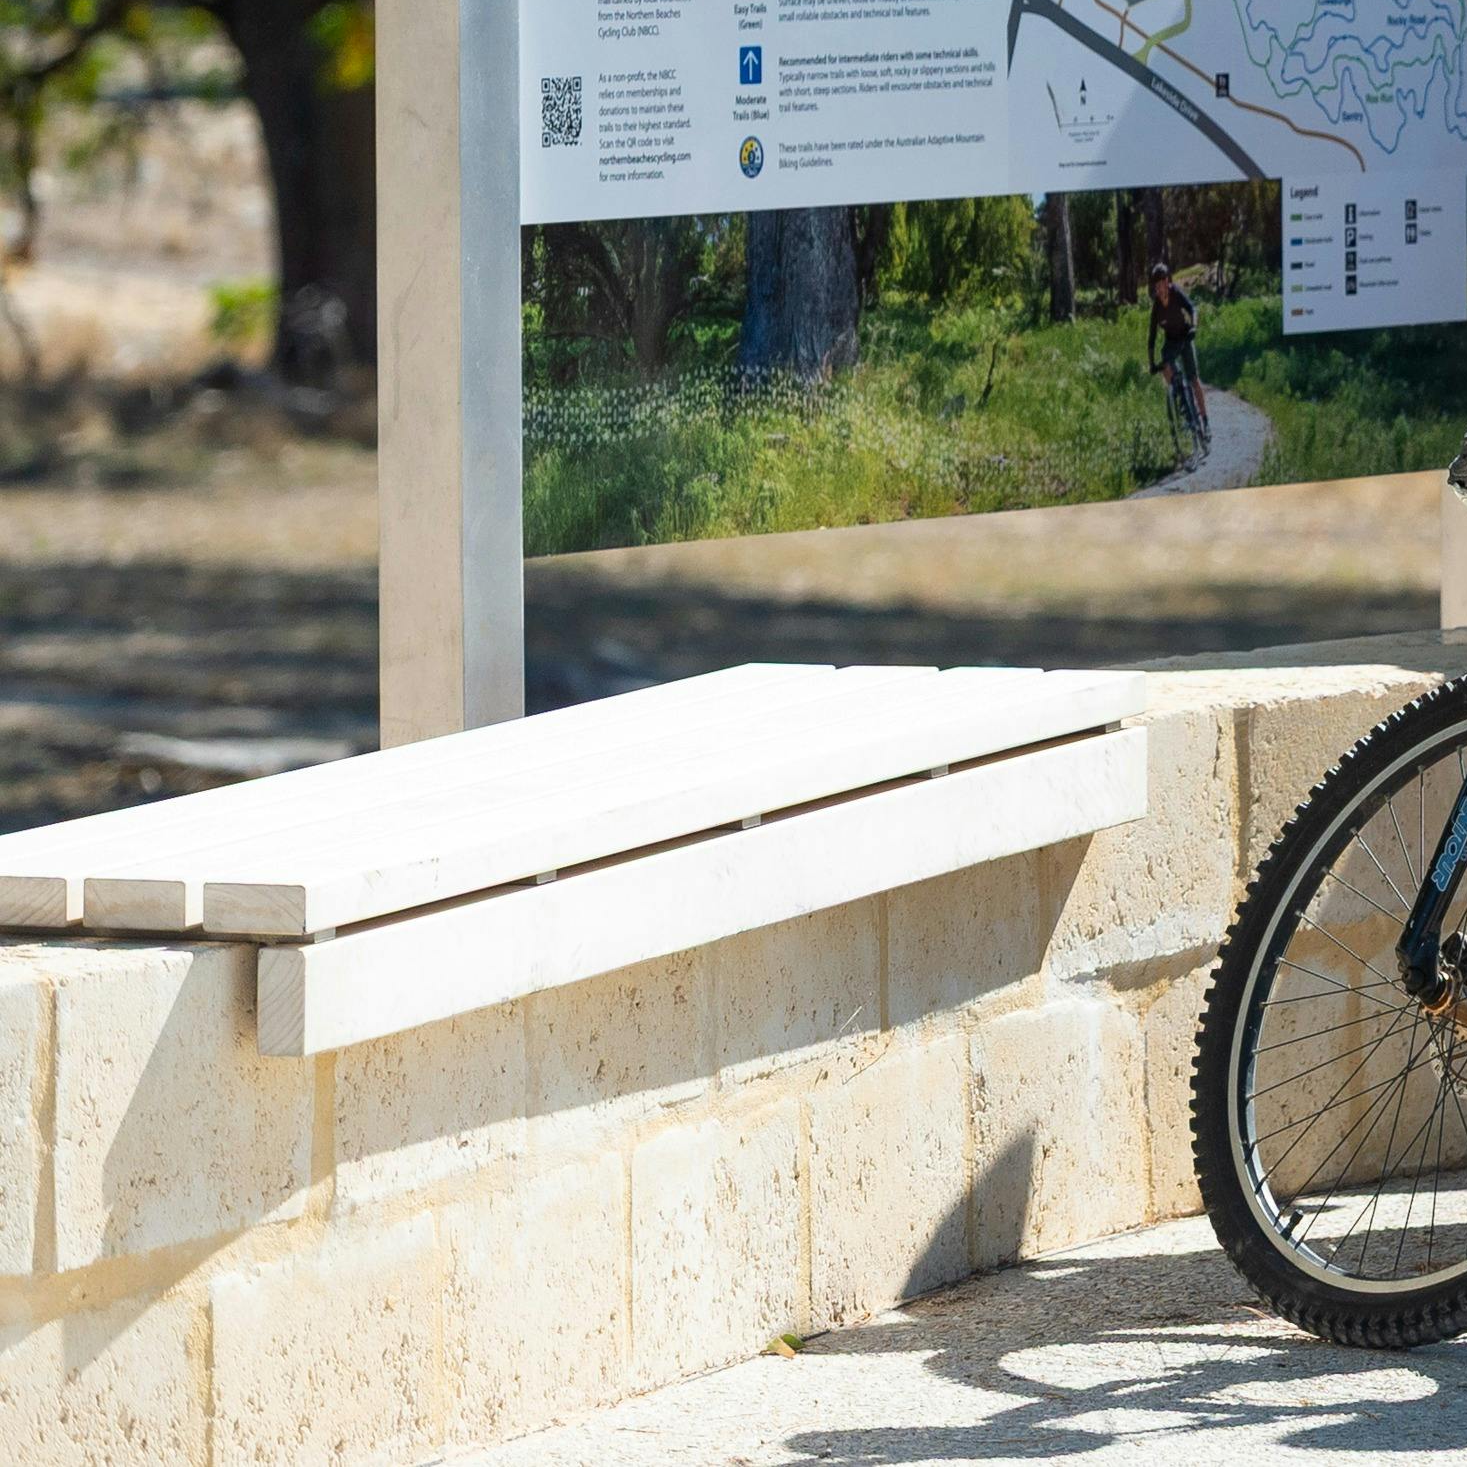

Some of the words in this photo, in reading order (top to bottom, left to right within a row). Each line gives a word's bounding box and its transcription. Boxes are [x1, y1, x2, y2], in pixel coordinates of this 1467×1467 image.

[733, 4, 748, 16] Easy
[749, 3, 766, 13] Trails
[738, 19, 762, 29] (Green)
[735, 94, 767, 105] Moderate
[732, 110, 749, 121] Trails
[750, 109, 769, 120] (Blue)
[1290, 186, 1319, 201] Legend
